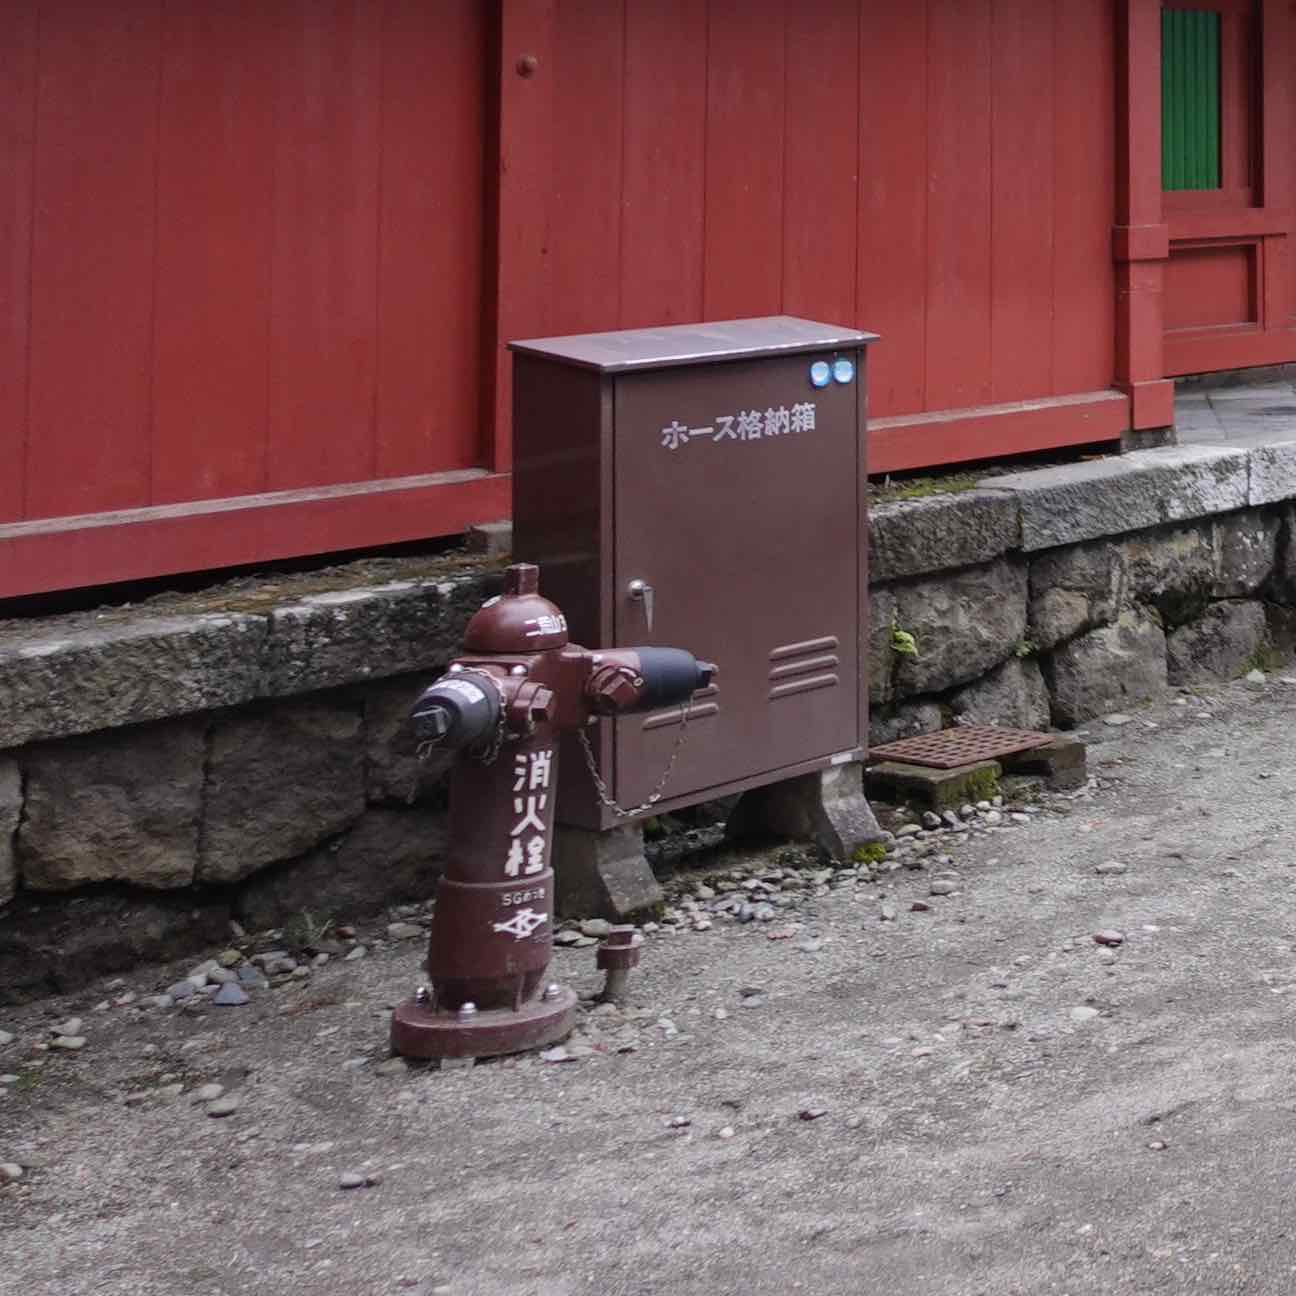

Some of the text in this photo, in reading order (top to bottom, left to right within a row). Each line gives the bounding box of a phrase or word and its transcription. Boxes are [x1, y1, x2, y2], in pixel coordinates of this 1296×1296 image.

[661, 402, 816, 450] ホース格納箱
[504, 750, 552, 877] 消火栓
